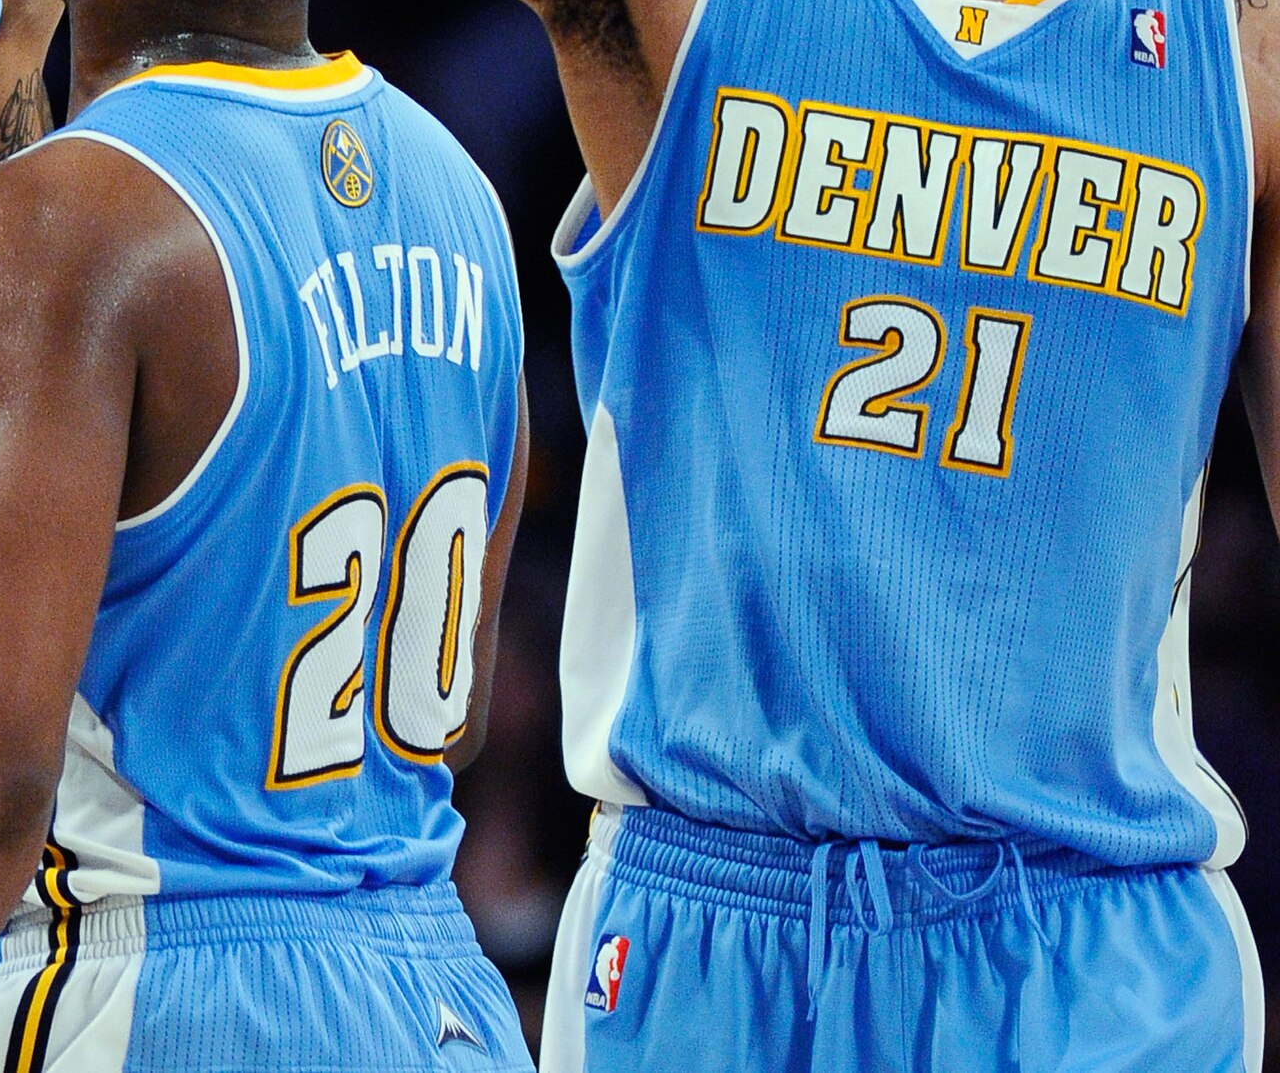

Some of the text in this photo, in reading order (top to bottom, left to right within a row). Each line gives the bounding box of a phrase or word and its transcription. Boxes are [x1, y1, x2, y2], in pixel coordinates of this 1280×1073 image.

[955, 6, 989, 46] N
[1133, 50, 1156, 65] NBA
[696, 87, 1206, 316] DENVER
[813, 294, 1033, 479] 21
[265, 459, 490, 791] 20
[585, 990, 607, 1008] NBA
